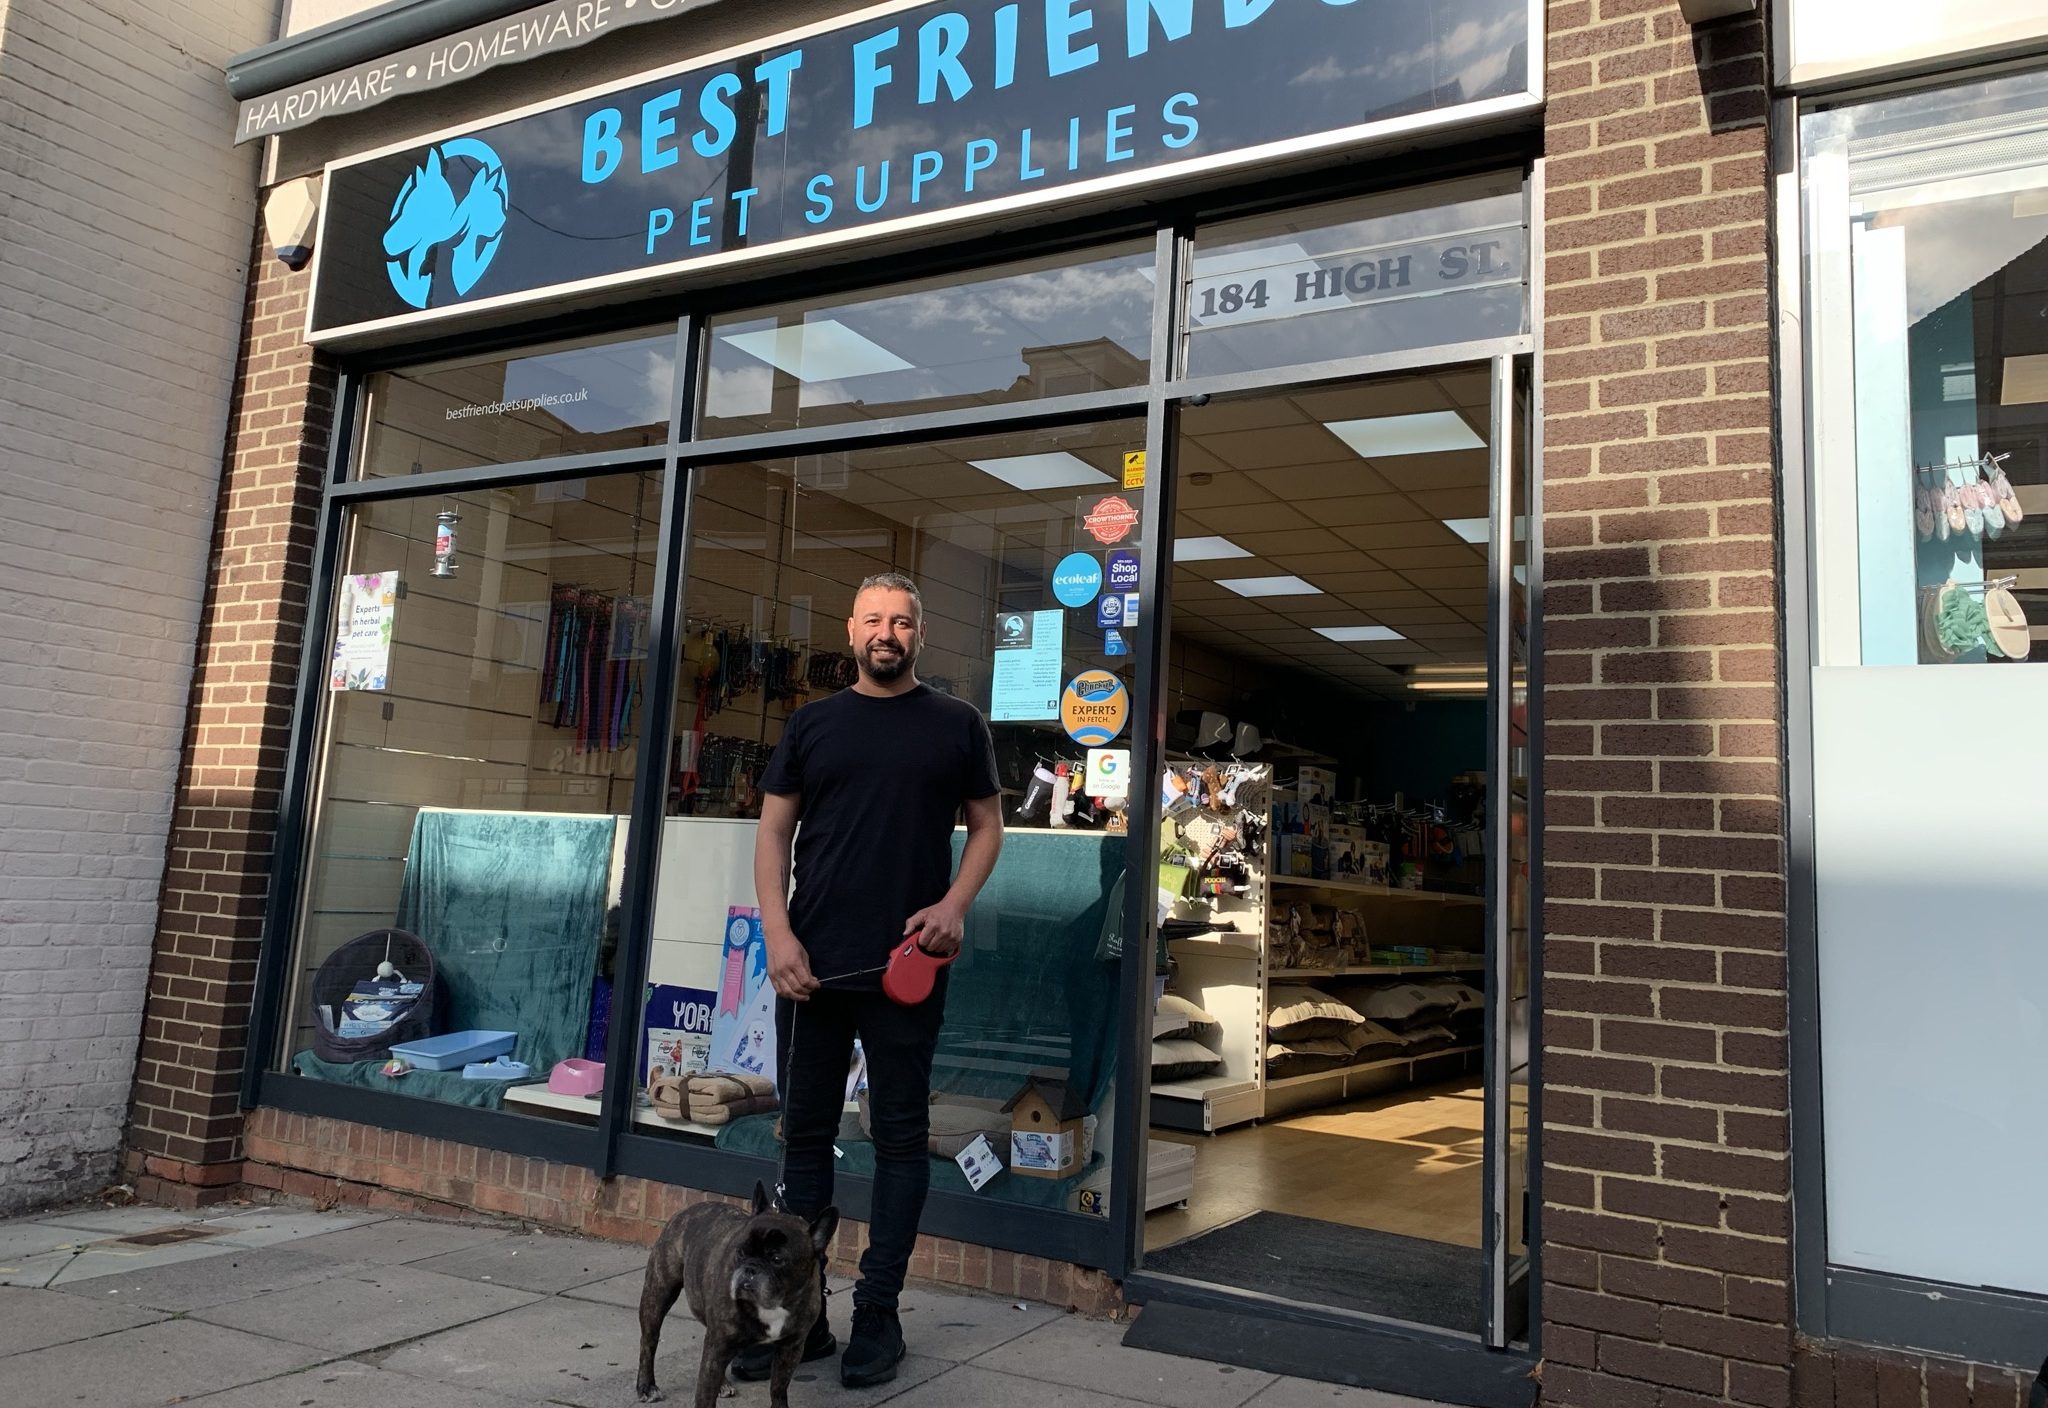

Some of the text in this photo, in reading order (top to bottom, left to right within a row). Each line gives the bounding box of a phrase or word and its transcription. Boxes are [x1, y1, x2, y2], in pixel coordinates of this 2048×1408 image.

[245, 2, 611, 134] HARDWARE HOMEWARE
[581, 0, 1360, 184] BEST FRIEN
[646, 92, 1200, 256] PET SUPPLIES
[1199, 279, 1270, 318] 184
[1293, 254, 1412, 303] HIGH
[445, 387, 589, 421] bestfriendspetsupplies.co.uk
[1125, 477, 1145, 487] CCTV
[1088, 513, 1135, 523] CROWTHORNE
[1112, 564, 1138, 574] Shop
[1055, 573, 1099, 585] ecoleaf
[1111, 573, 1138, 583] Local
[356, 605, 380, 615] Experts
[359, 616, 380, 626] herbal
[352, 631, 363, 639] pet
[1072, 705, 1117, 715] EXPERTS
[1077, 716, 1086, 724] IN
[1101, 782, 1121, 792] Google
